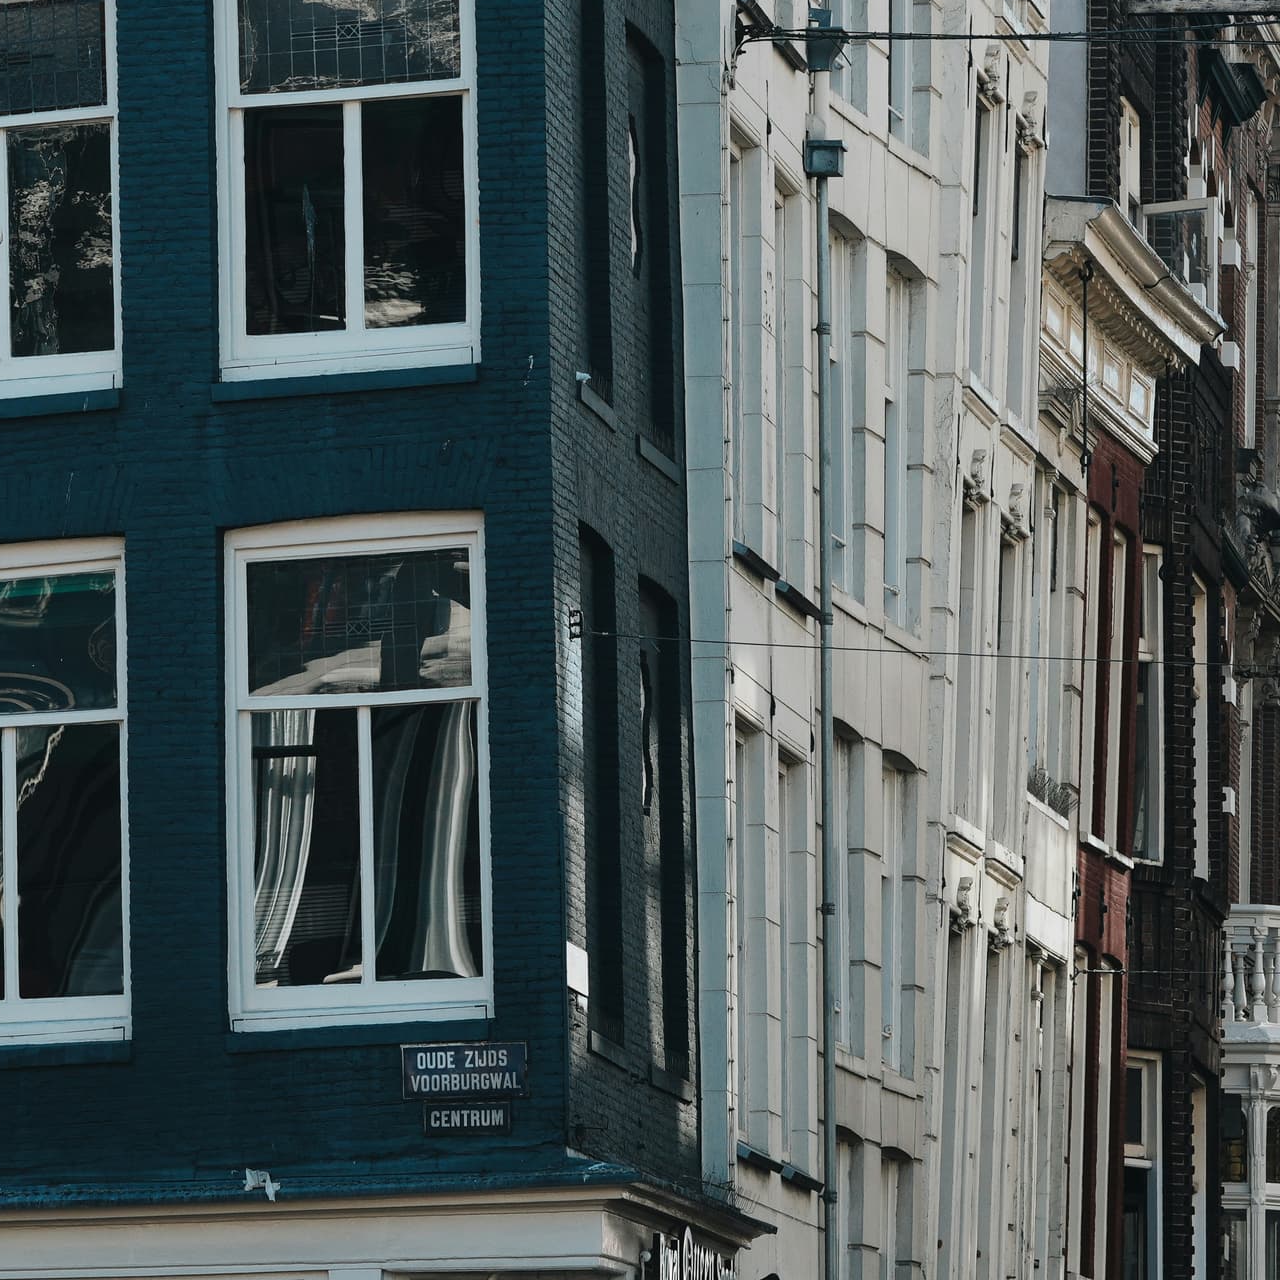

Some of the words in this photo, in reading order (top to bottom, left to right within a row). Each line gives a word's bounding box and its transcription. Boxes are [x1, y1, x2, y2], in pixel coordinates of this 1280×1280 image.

[417, 1051, 455, 1069] OUDE
[465, 1049, 507, 1068] ZIJDS
[411, 1072, 520, 1092] VOORBURGWAL
[430, 1108, 504, 1127] CENTRUM
